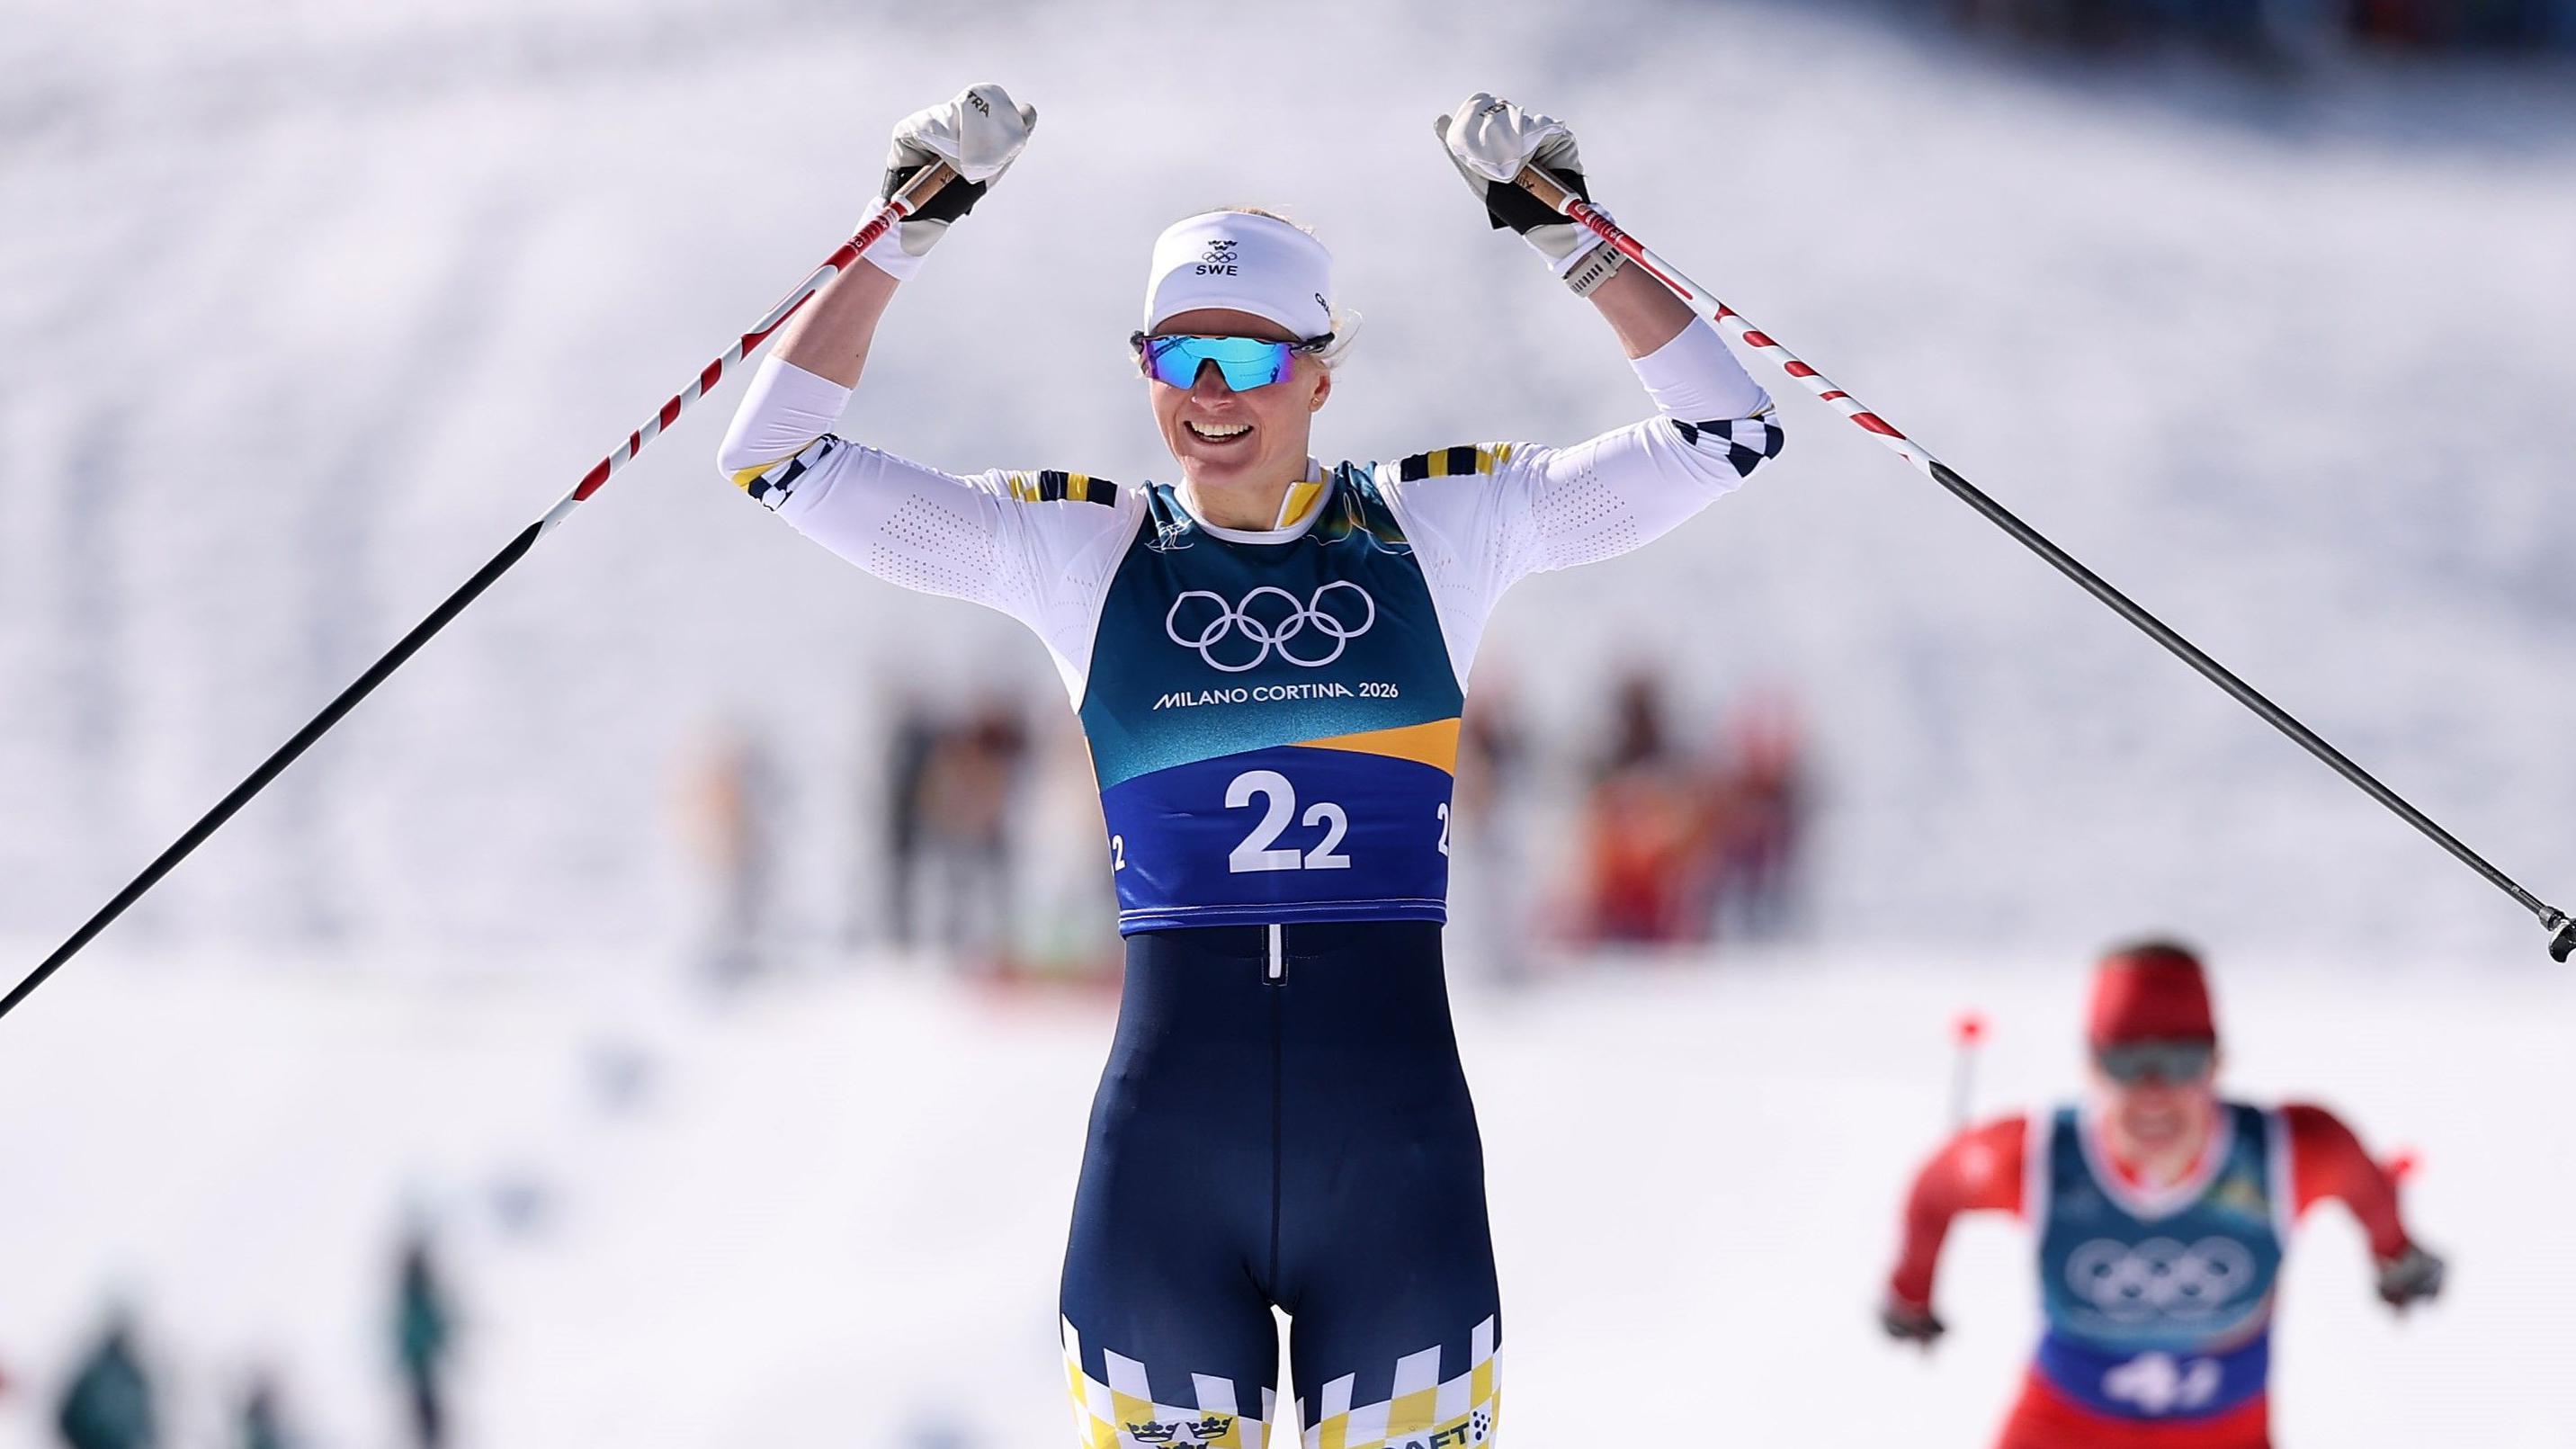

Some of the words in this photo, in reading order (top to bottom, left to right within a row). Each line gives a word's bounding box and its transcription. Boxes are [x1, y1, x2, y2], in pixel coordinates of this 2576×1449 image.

[1195, 264, 1239, 276] SWE
[1152, 685, 1248, 711] MILANO
[1252, 682, 1355, 705] CORTINA
[1359, 682, 1399, 699] 2026
[1437, 802, 1448, 857] 2
[1112, 835, 1126, 872] 2
